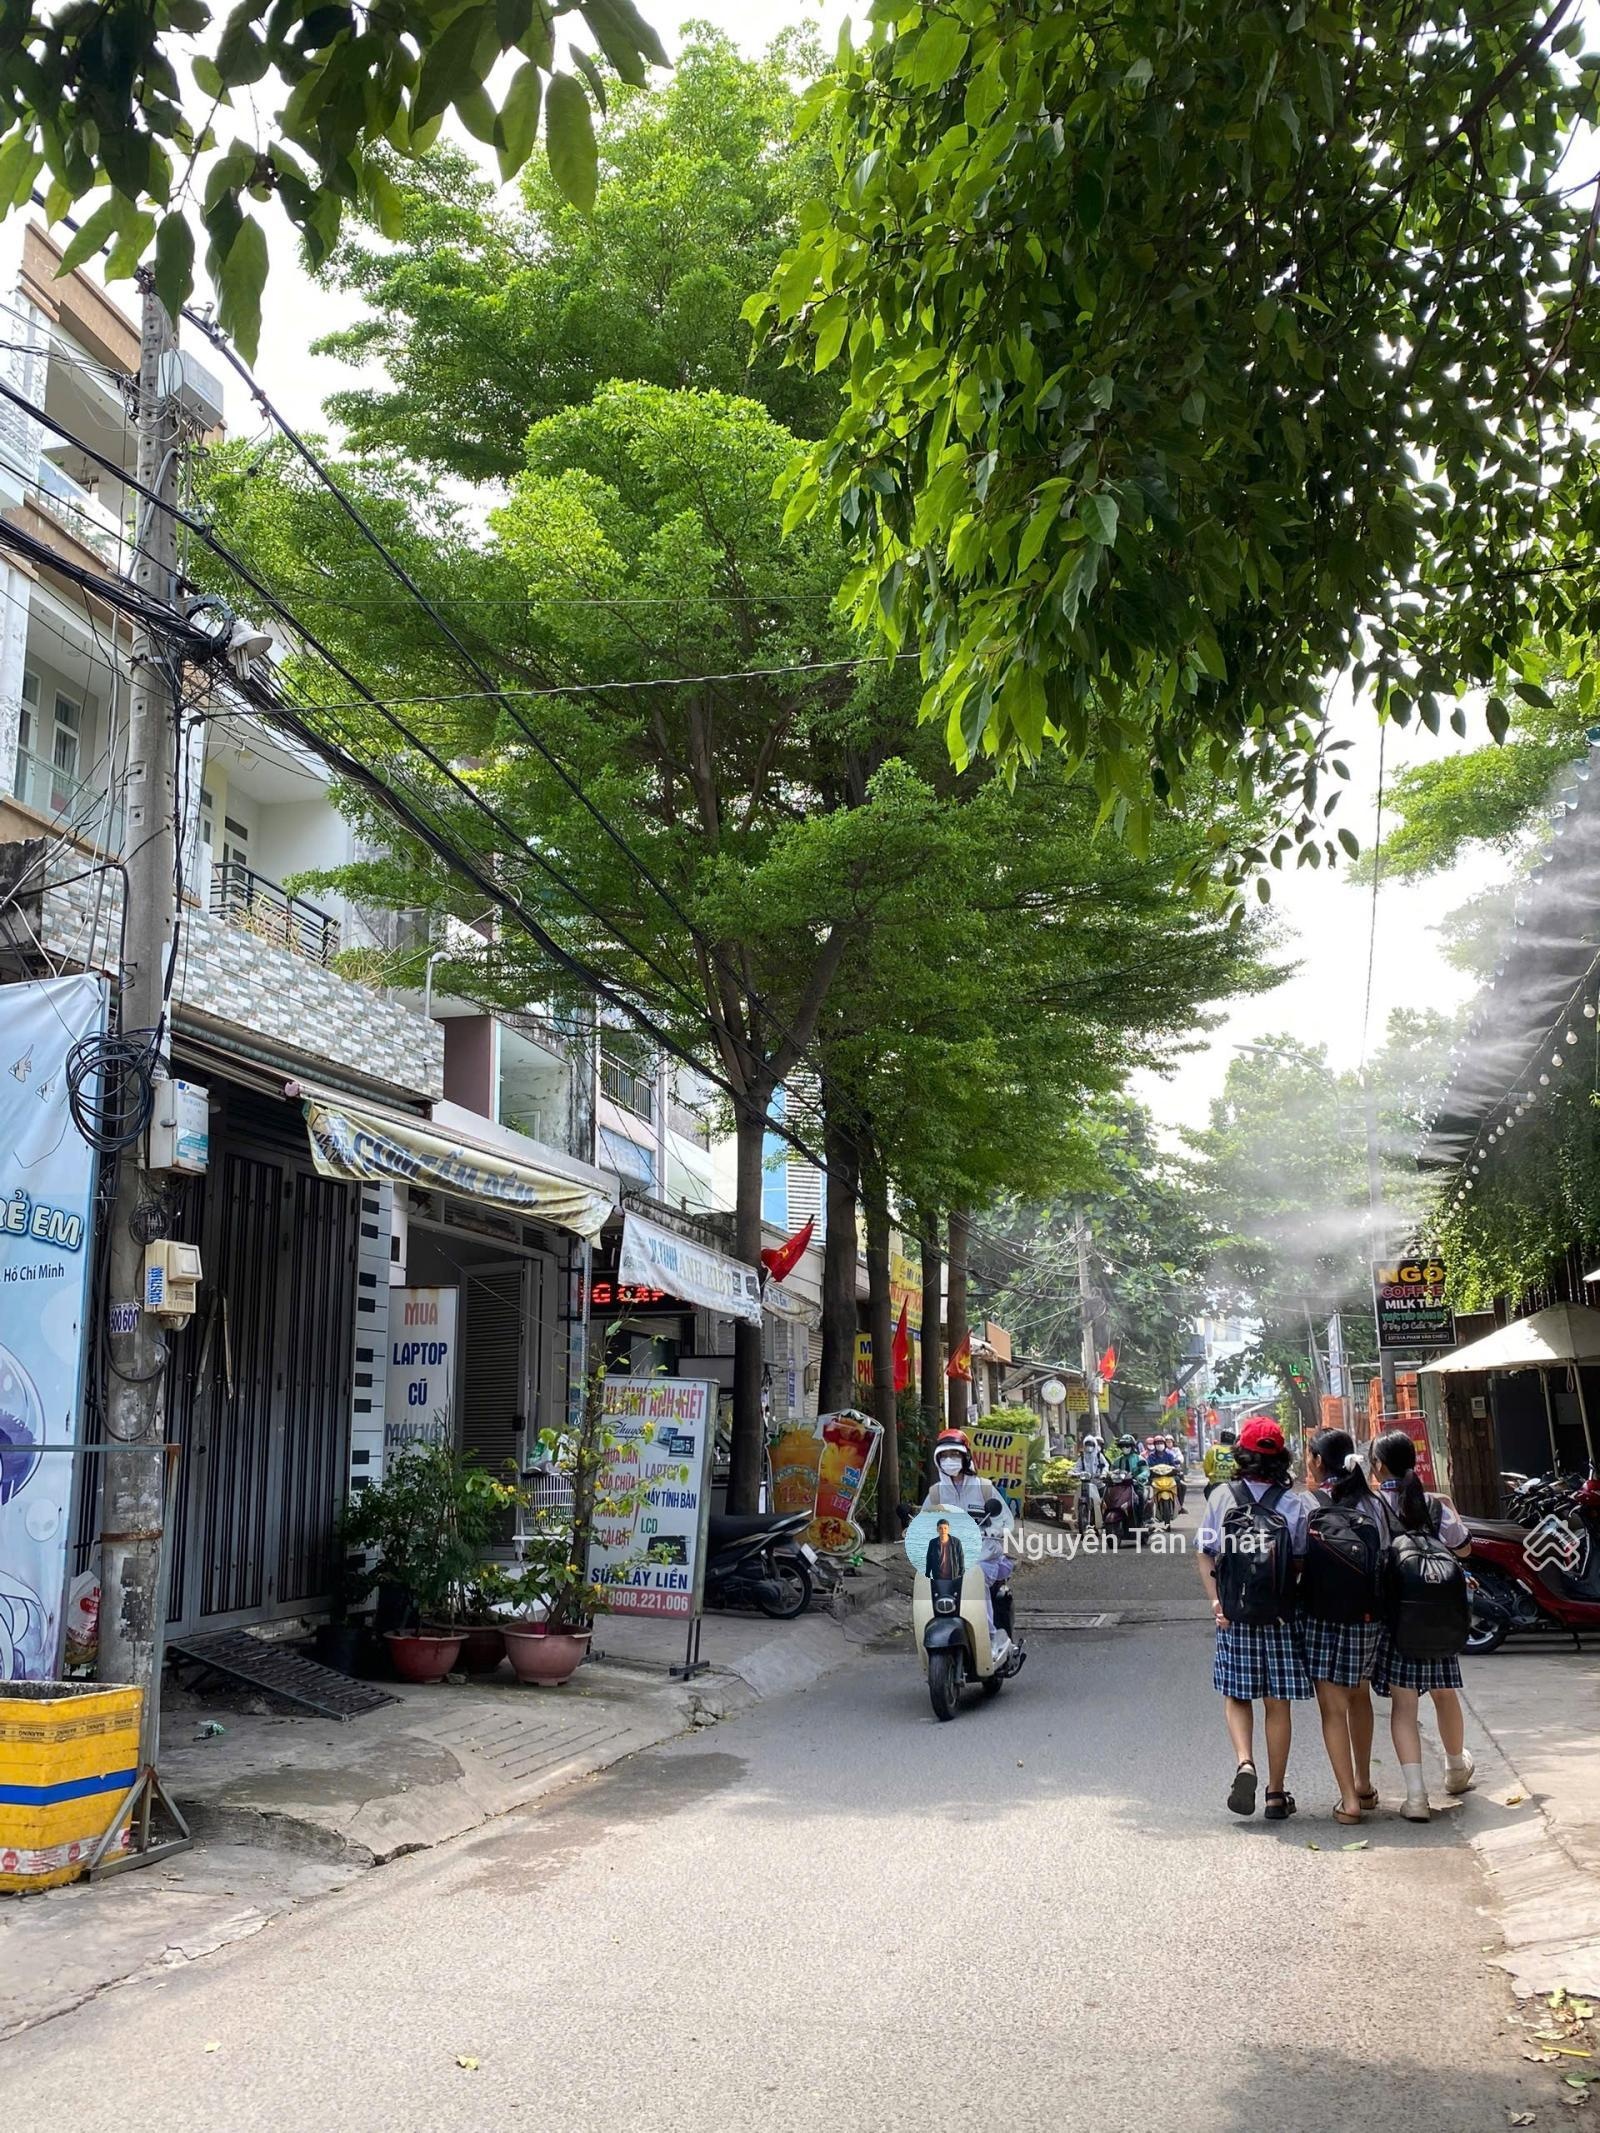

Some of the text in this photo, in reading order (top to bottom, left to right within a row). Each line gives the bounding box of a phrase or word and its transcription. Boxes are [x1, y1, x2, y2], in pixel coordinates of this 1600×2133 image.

[31, 1204, 81, 1247] EM
[4, 1262, 65, 1282] Hồ Chí Minh
[404, 1302, 438, 1325] MUA
[1385, 1298, 1443, 1310] MILK TEA
[392, 1342, 448, 1366] LAPTOP
[408, 1378, 428, 1406] CŨ
[973, 1432, 1014, 1452] CHỤP
[972, 1448, 1025, 1475] NH THẺ
[661, 1488, 680, 1508] TÍNH
[680, 1490, 697, 1510] BÀN
[640, 1517, 659, 1534] LCD
[655, 1567, 689, 1590] LIỀN
[607, 1591, 689, 1613] 0908.221.006
